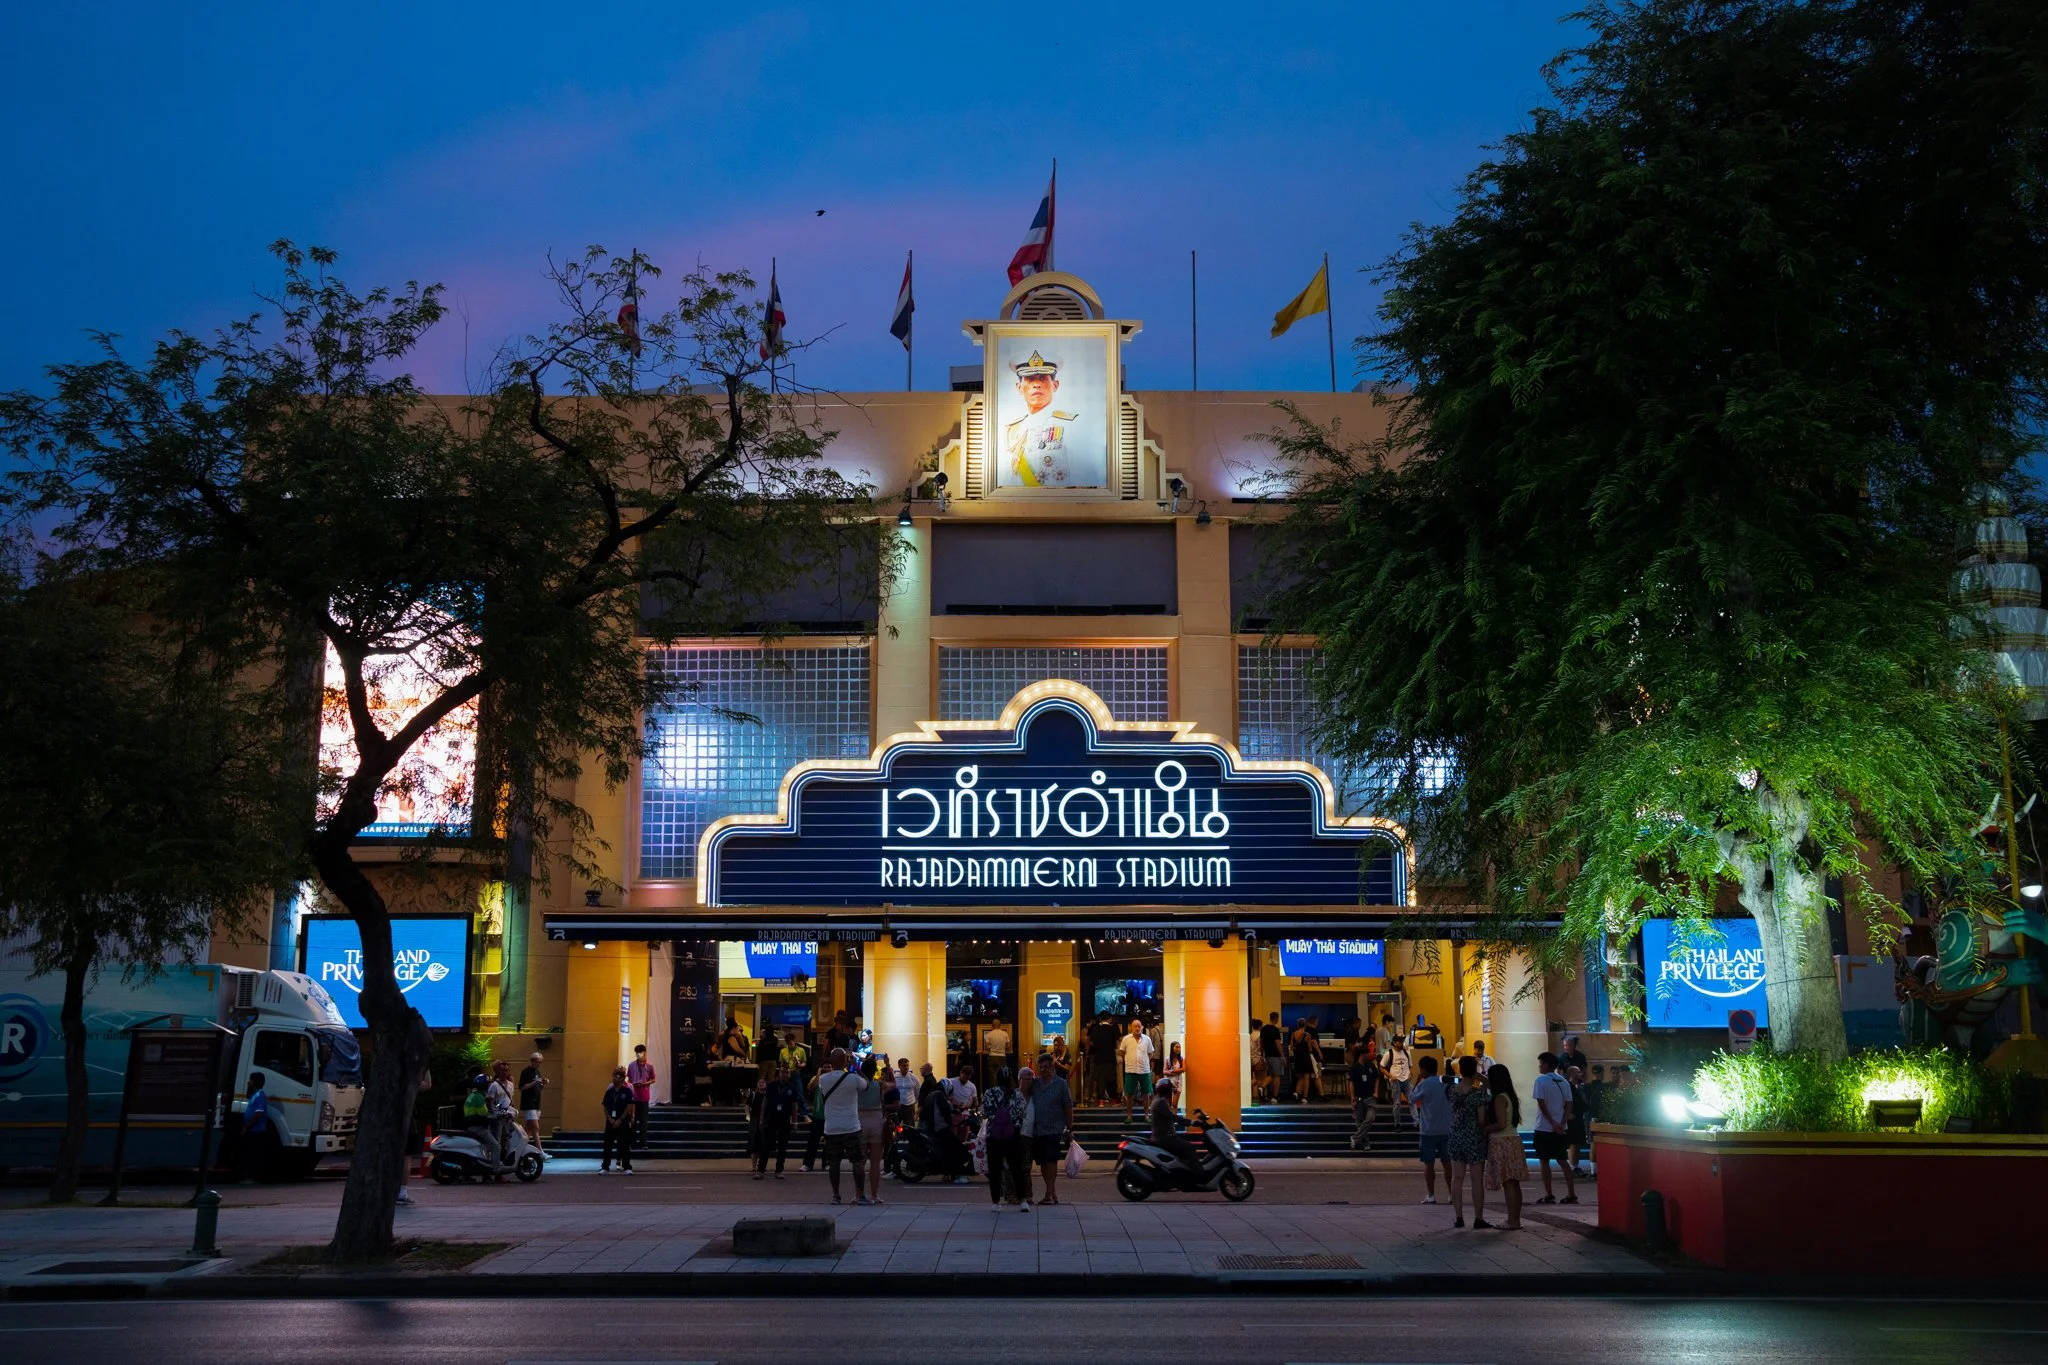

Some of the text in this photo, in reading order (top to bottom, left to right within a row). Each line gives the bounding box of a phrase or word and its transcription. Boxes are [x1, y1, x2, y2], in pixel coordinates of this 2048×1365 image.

[881, 857, 1231, 888] RAJADAMNERN STADIUM
[757, 930, 876, 941] RAJADAMNERN STADIUM
[1104, 930, 1224, 940] RAJADAMNERN STADIUM
[751, 942, 778, 955] MUAY
[782, 943, 802, 955] THAI
[1285, 940, 1378, 955] MUAY THAI STADIUM
[344, 949, 430, 964] THAND
[322, 961, 421, 981] PRIVGE
[1660, 961, 1762, 981] PRIVILEGE
